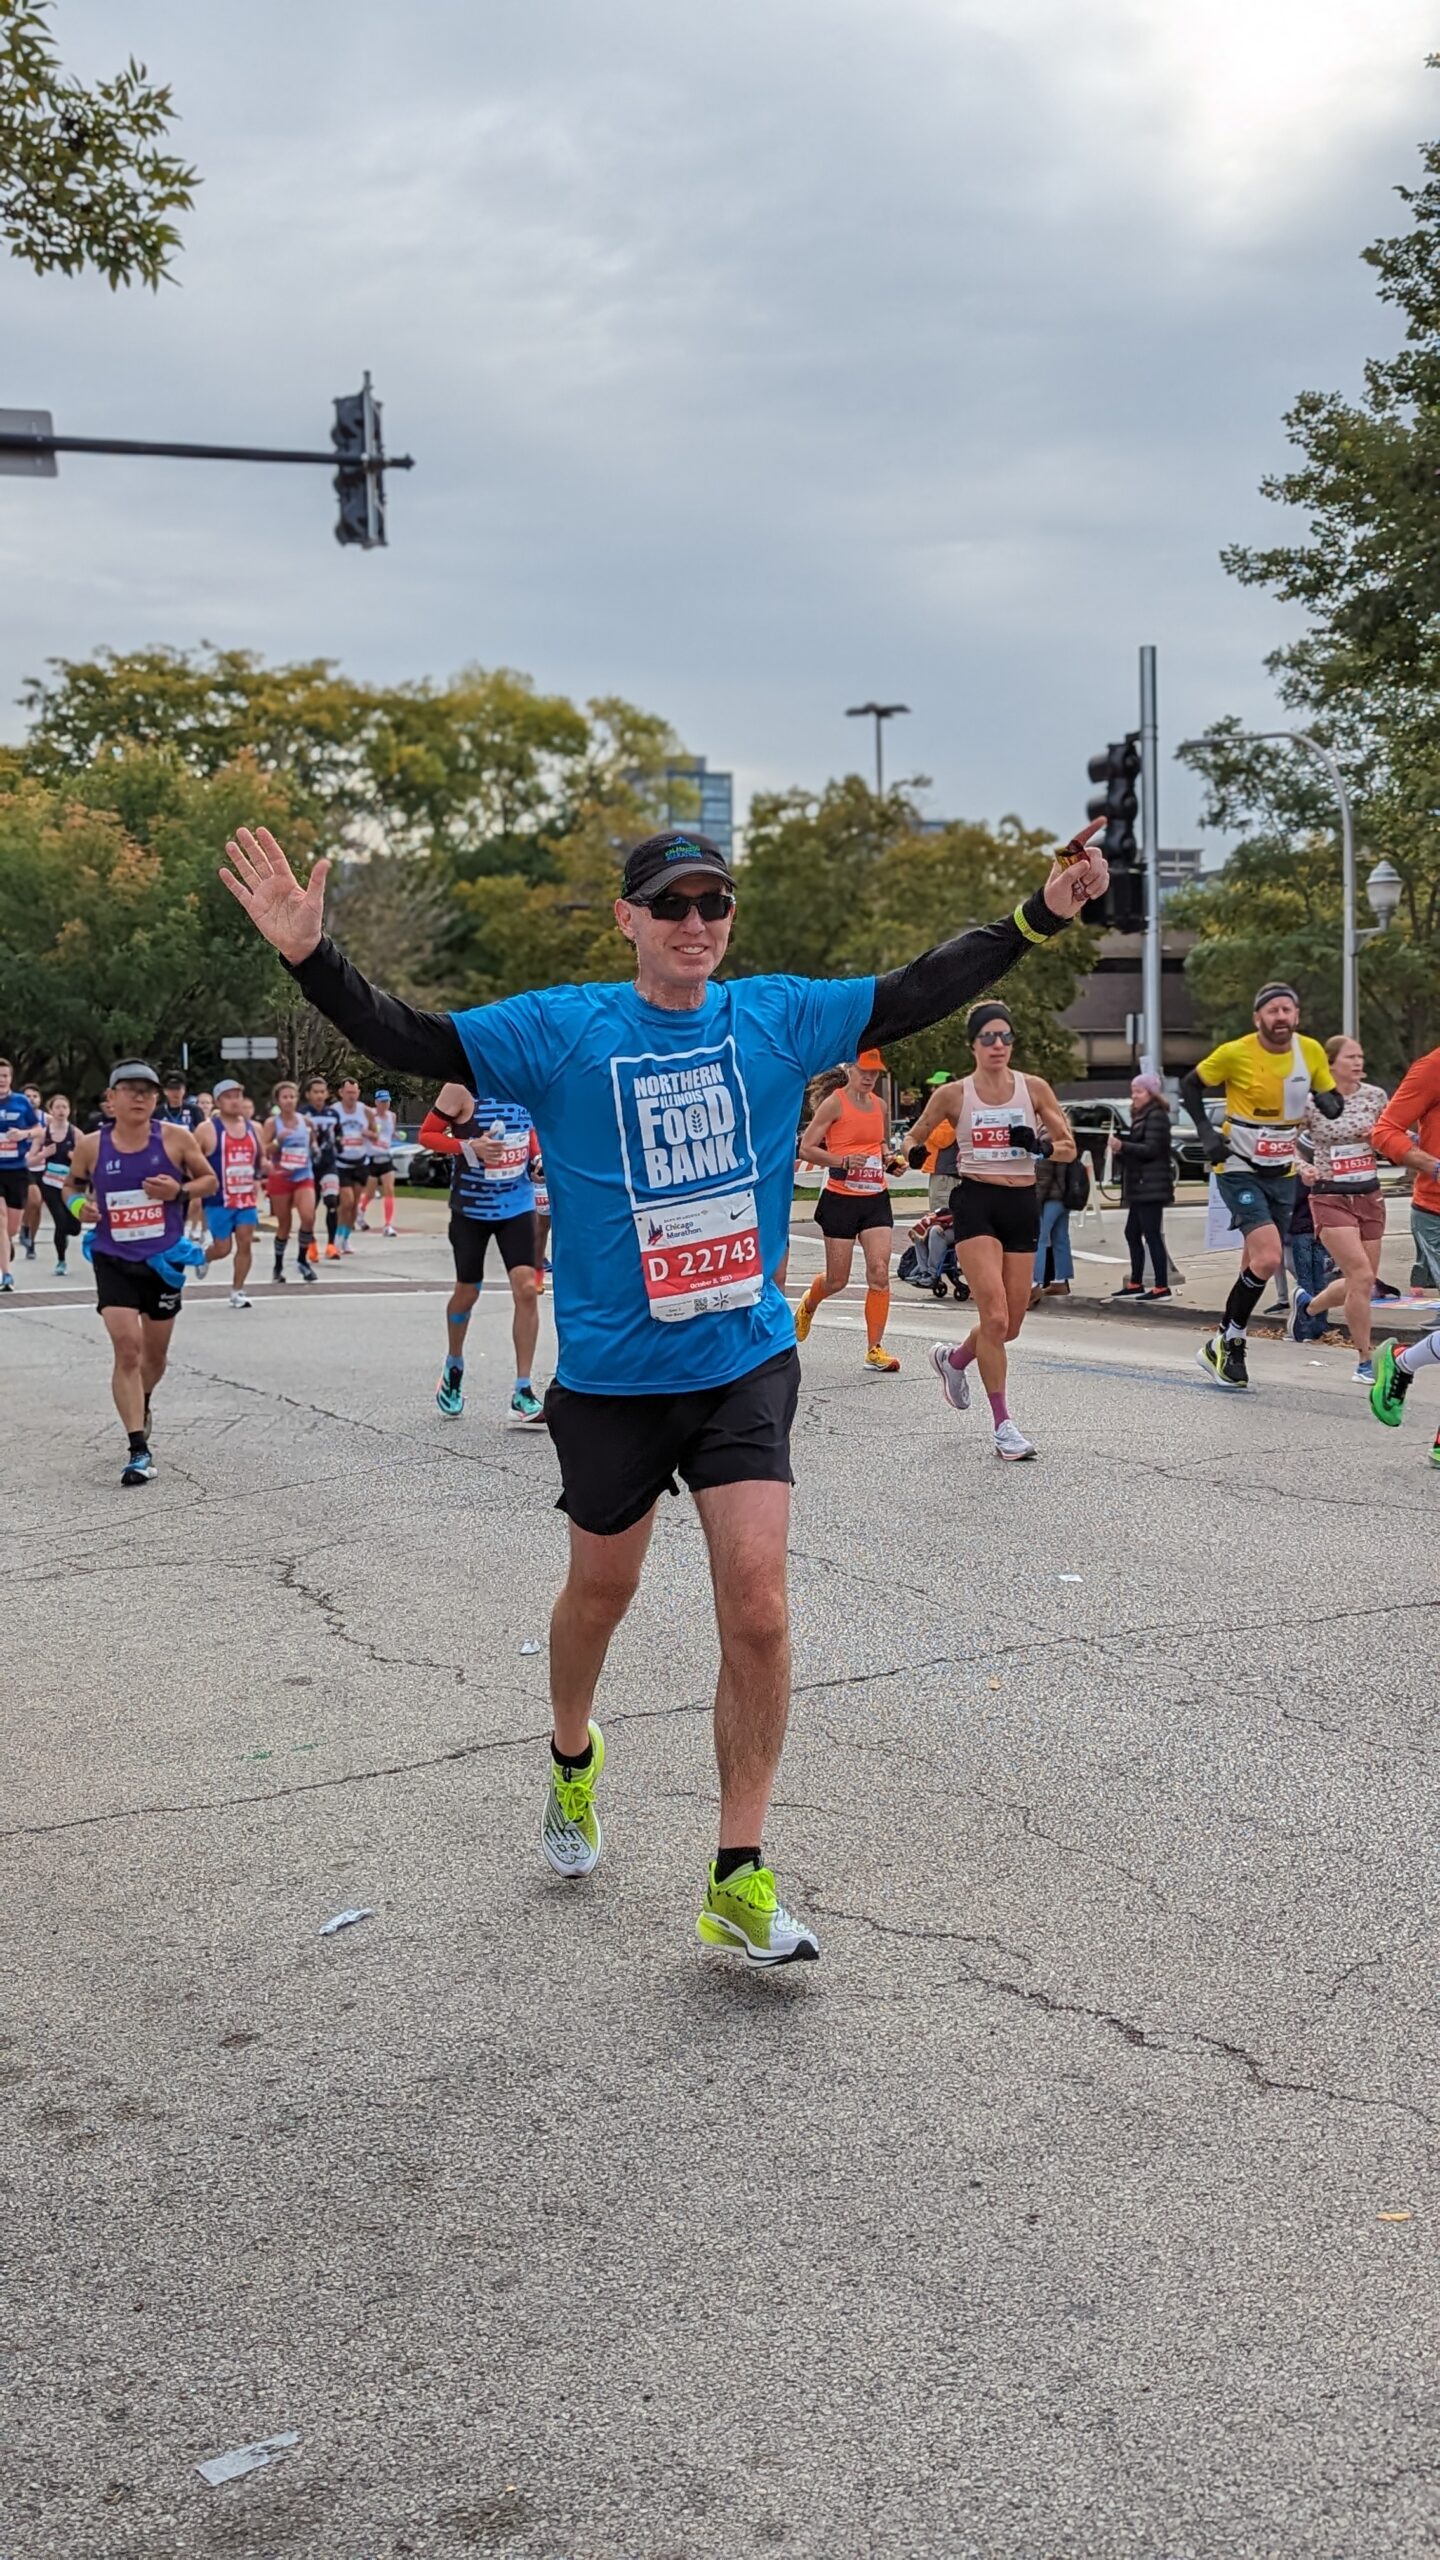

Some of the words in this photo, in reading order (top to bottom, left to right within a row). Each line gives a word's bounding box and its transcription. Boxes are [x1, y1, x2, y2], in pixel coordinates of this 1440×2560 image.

[633, 1063, 724, 1098] NORTHERN
[660, 1089, 704, 1109] ILLINOIS
[636, 1085, 736, 1149] FOOD
[973, 1131, 983, 1141] D
[111, 1212, 120, 1223] D
[122, 1207, 163, 1223] 24768
[665, 1221, 694, 1232] Chicago
[647, 1257, 669, 1282] D
[678, 1237, 756, 1276] 22743
[690, 1280, 712, 1289] October
